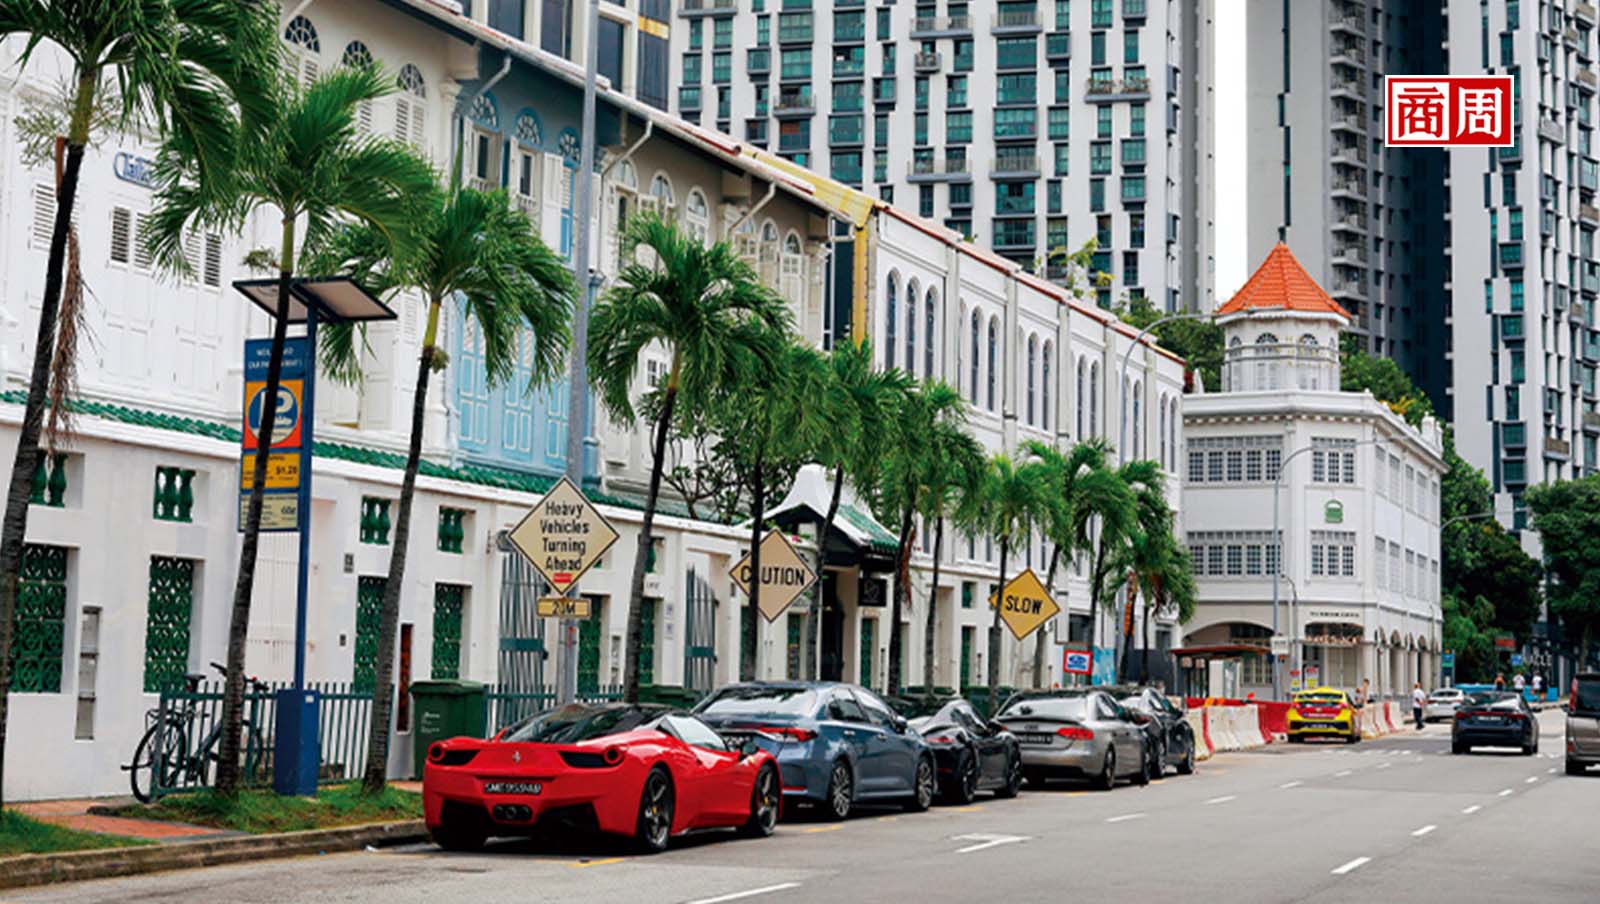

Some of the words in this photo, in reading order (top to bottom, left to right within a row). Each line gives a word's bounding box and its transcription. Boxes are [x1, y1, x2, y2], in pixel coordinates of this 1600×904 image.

[545, 502, 584, 518] Heavy
[540, 519, 590, 534] Vehicles
[543, 537, 587, 554] Turning
[545, 556, 582, 571] Ahead
[740, 565, 805, 586] CUTION
[1005, 595, 1043, 615] SLOW
